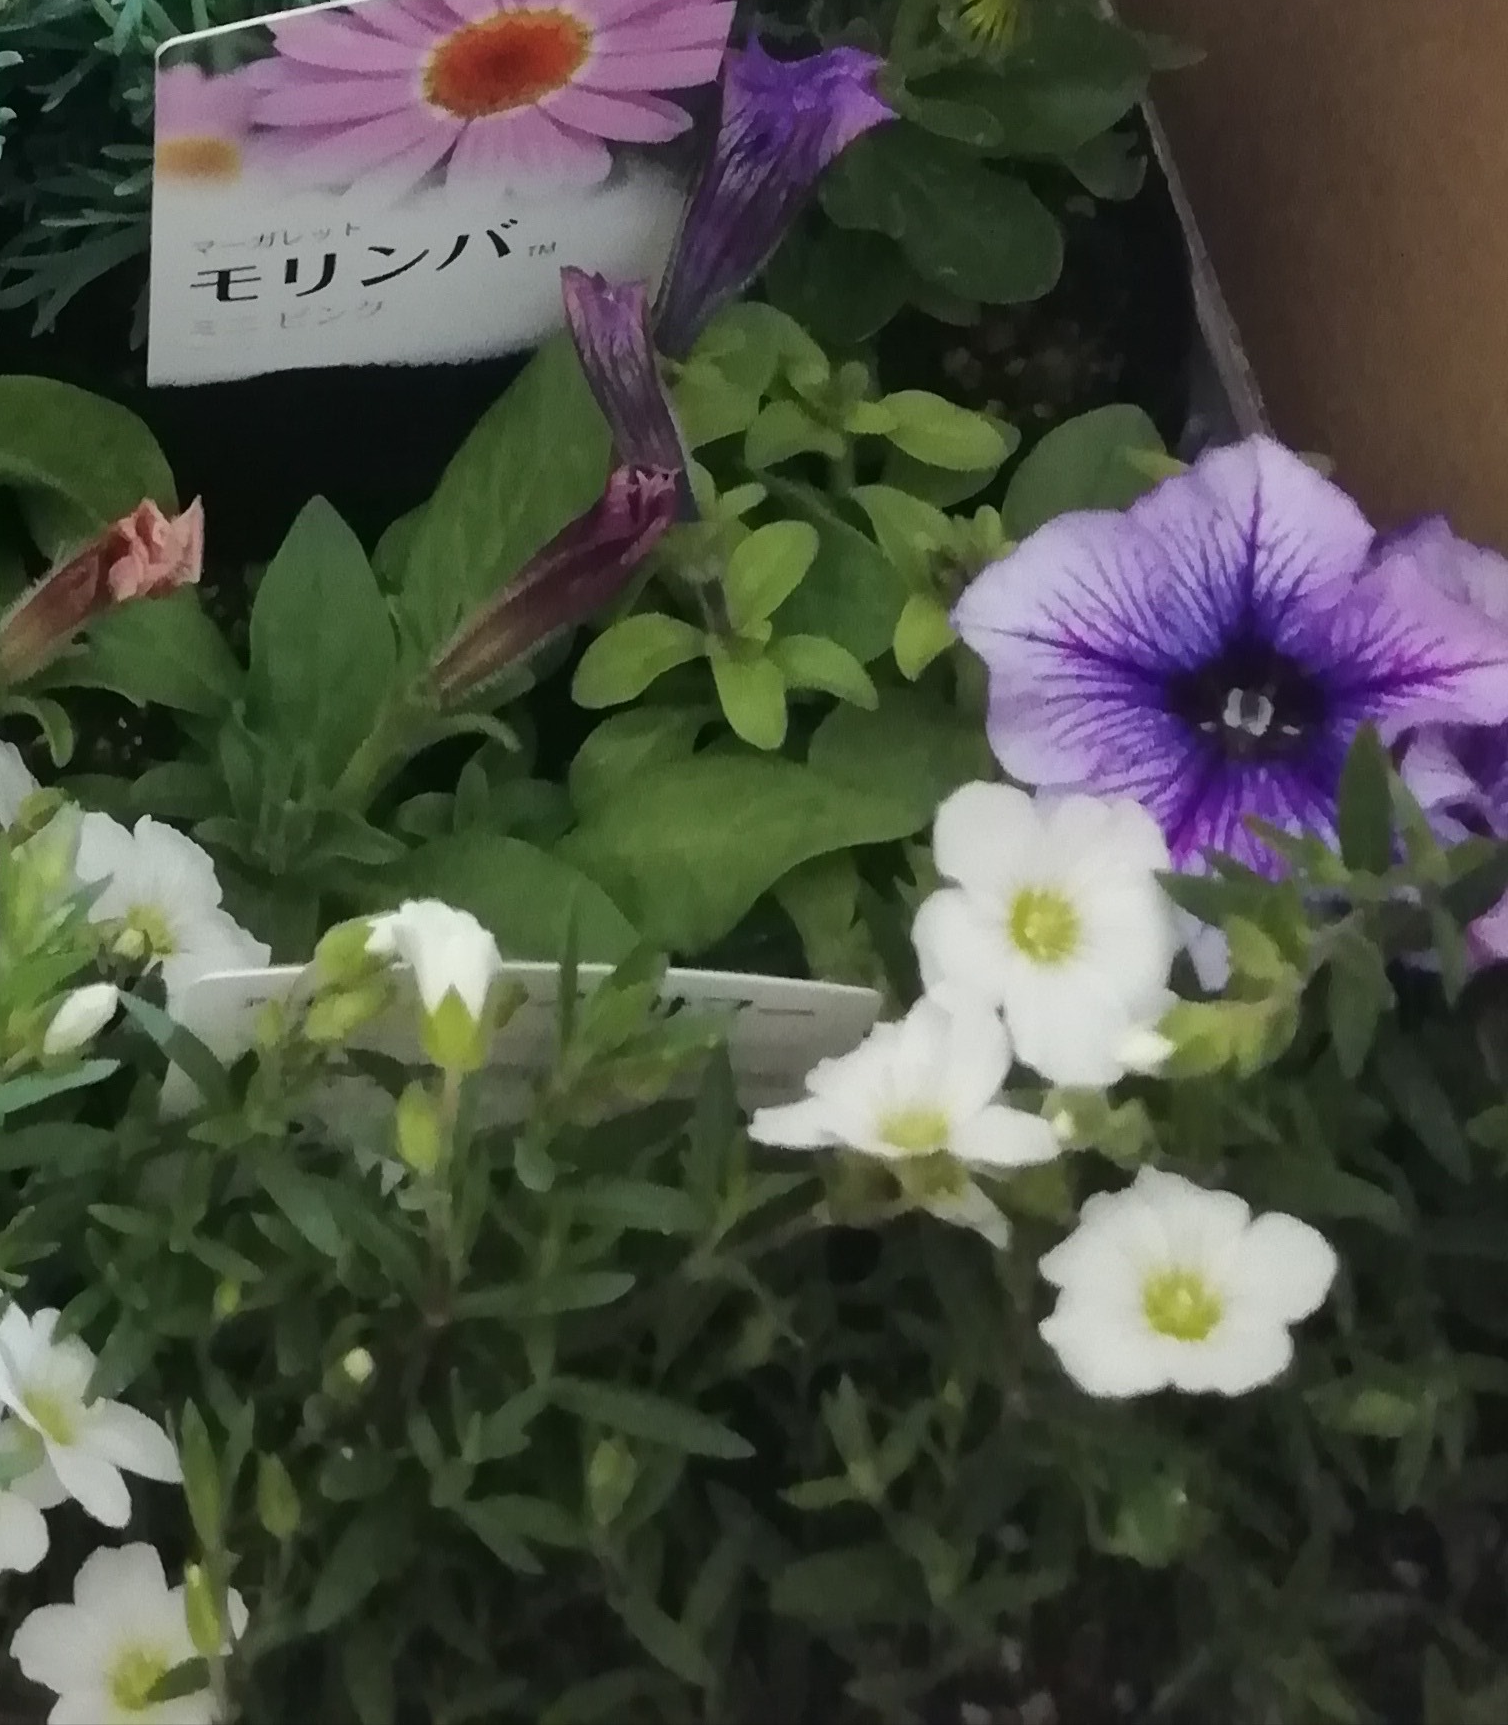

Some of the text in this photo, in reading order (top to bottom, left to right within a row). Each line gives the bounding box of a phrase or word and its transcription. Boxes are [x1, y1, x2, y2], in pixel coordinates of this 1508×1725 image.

[190, 218, 518, 302] モリンバ
[193, 222, 361, 254] マーガレット
